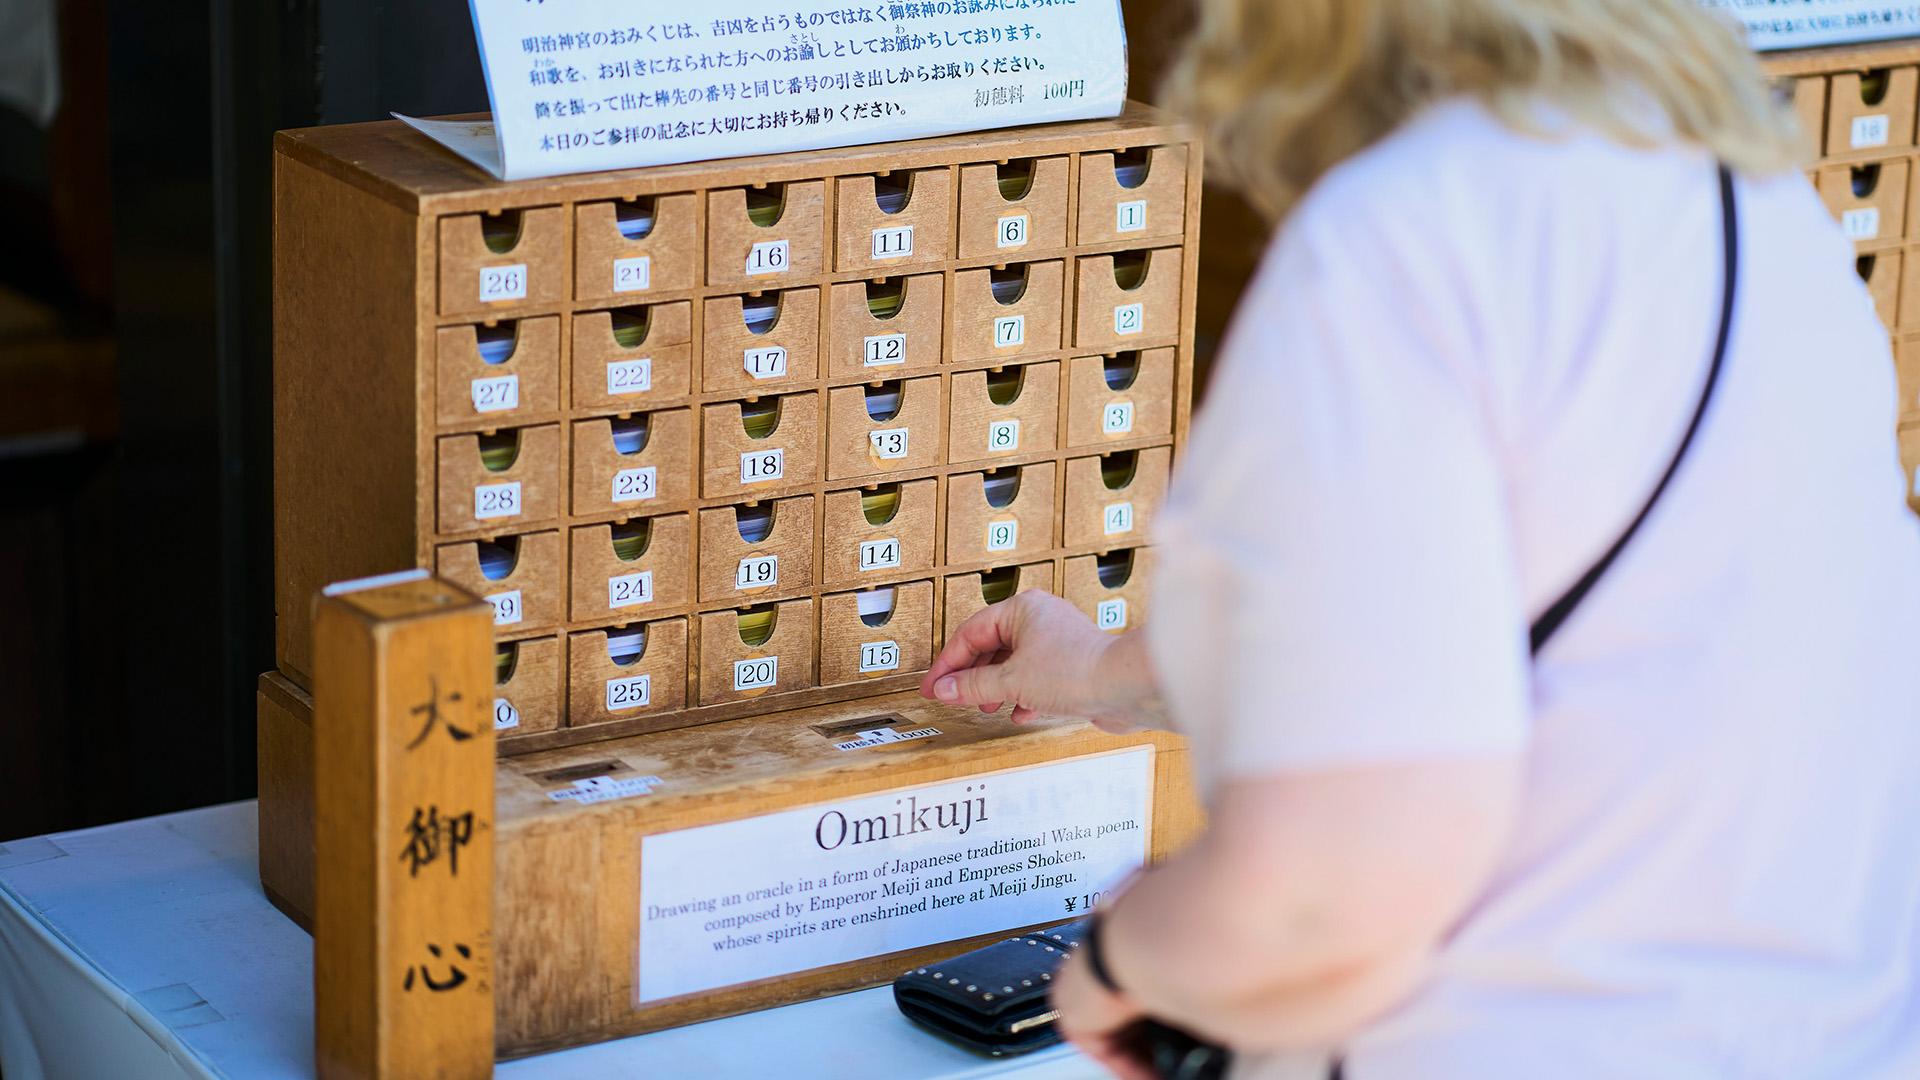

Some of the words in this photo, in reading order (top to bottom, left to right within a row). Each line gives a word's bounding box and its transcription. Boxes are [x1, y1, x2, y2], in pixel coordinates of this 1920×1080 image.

[521, 0, 1076, 53] 明治神宮のおみくじは、吉凶を占うものではなく御祭神のお詠みになら
[1043, 79, 1085, 100] 100円
[1126, 207, 1136, 226] 1
[1006, 221, 1019, 241] 6
[879, 233, 904, 253] 11
[753, 246, 782, 267] 16
[488, 271, 519, 294] 26
[620, 267, 641, 281] 21
[1122, 310, 1134, 329] 2
[1003, 321, 1016, 341] 7
[872, 340, 899, 360] 12
[753, 352, 781, 374] 17
[615, 366, 643, 387] 22
[480, 382, 510, 405] 27
[1112, 408, 1123, 427] 3
[996, 427, 1010, 446] 8
[746, 454, 777, 477] 18
[619, 472, 650, 495] 23
[482, 489, 514, 512] 28
[1111, 510, 1124, 527] 4
[996, 527, 1009, 547] 9
[867, 544, 895, 566] 14
[742, 561, 771, 584] 19
[616, 578, 645, 599] 24
[1106, 604, 1118, 623] 5
[867, 645, 893, 666] 15
[742, 663, 770, 685] 20
[614, 682, 643, 703] 25
[815, 784, 988, 851] Omikuji
[647, 897, 717, 921] Drawing
[721, 893, 741, 907] an
[746, 881, 793, 902] oracle
[798, 877, 813, 892] in
[818, 877, 827, 888] a
[833, 870, 868, 886] form
[873, 861, 889, 877] of
[891, 850, 962, 876] Japanese
[967, 831, 1046, 860] traditional
[1051, 825, 1092, 844] Waka
[704, 904, 780, 932] composed
[785, 902, 804, 918] by
[809, 889, 877, 912] Emperor
[881, 876, 920, 898] Meiji
[924, 871, 953, 889] and
[959, 860, 1023, 884] Empress
[712, 934, 762, 951] whose
[766, 921, 816, 943] spirits
[821, 916, 847, 931] are
[851, 897, 926, 926] enshrined
[932, 895, 965, 911] here
[969, 888, 985, 902] at
[989, 877, 1027, 898] Meiji
[1031, 872, 1077, 889] Jingu.
